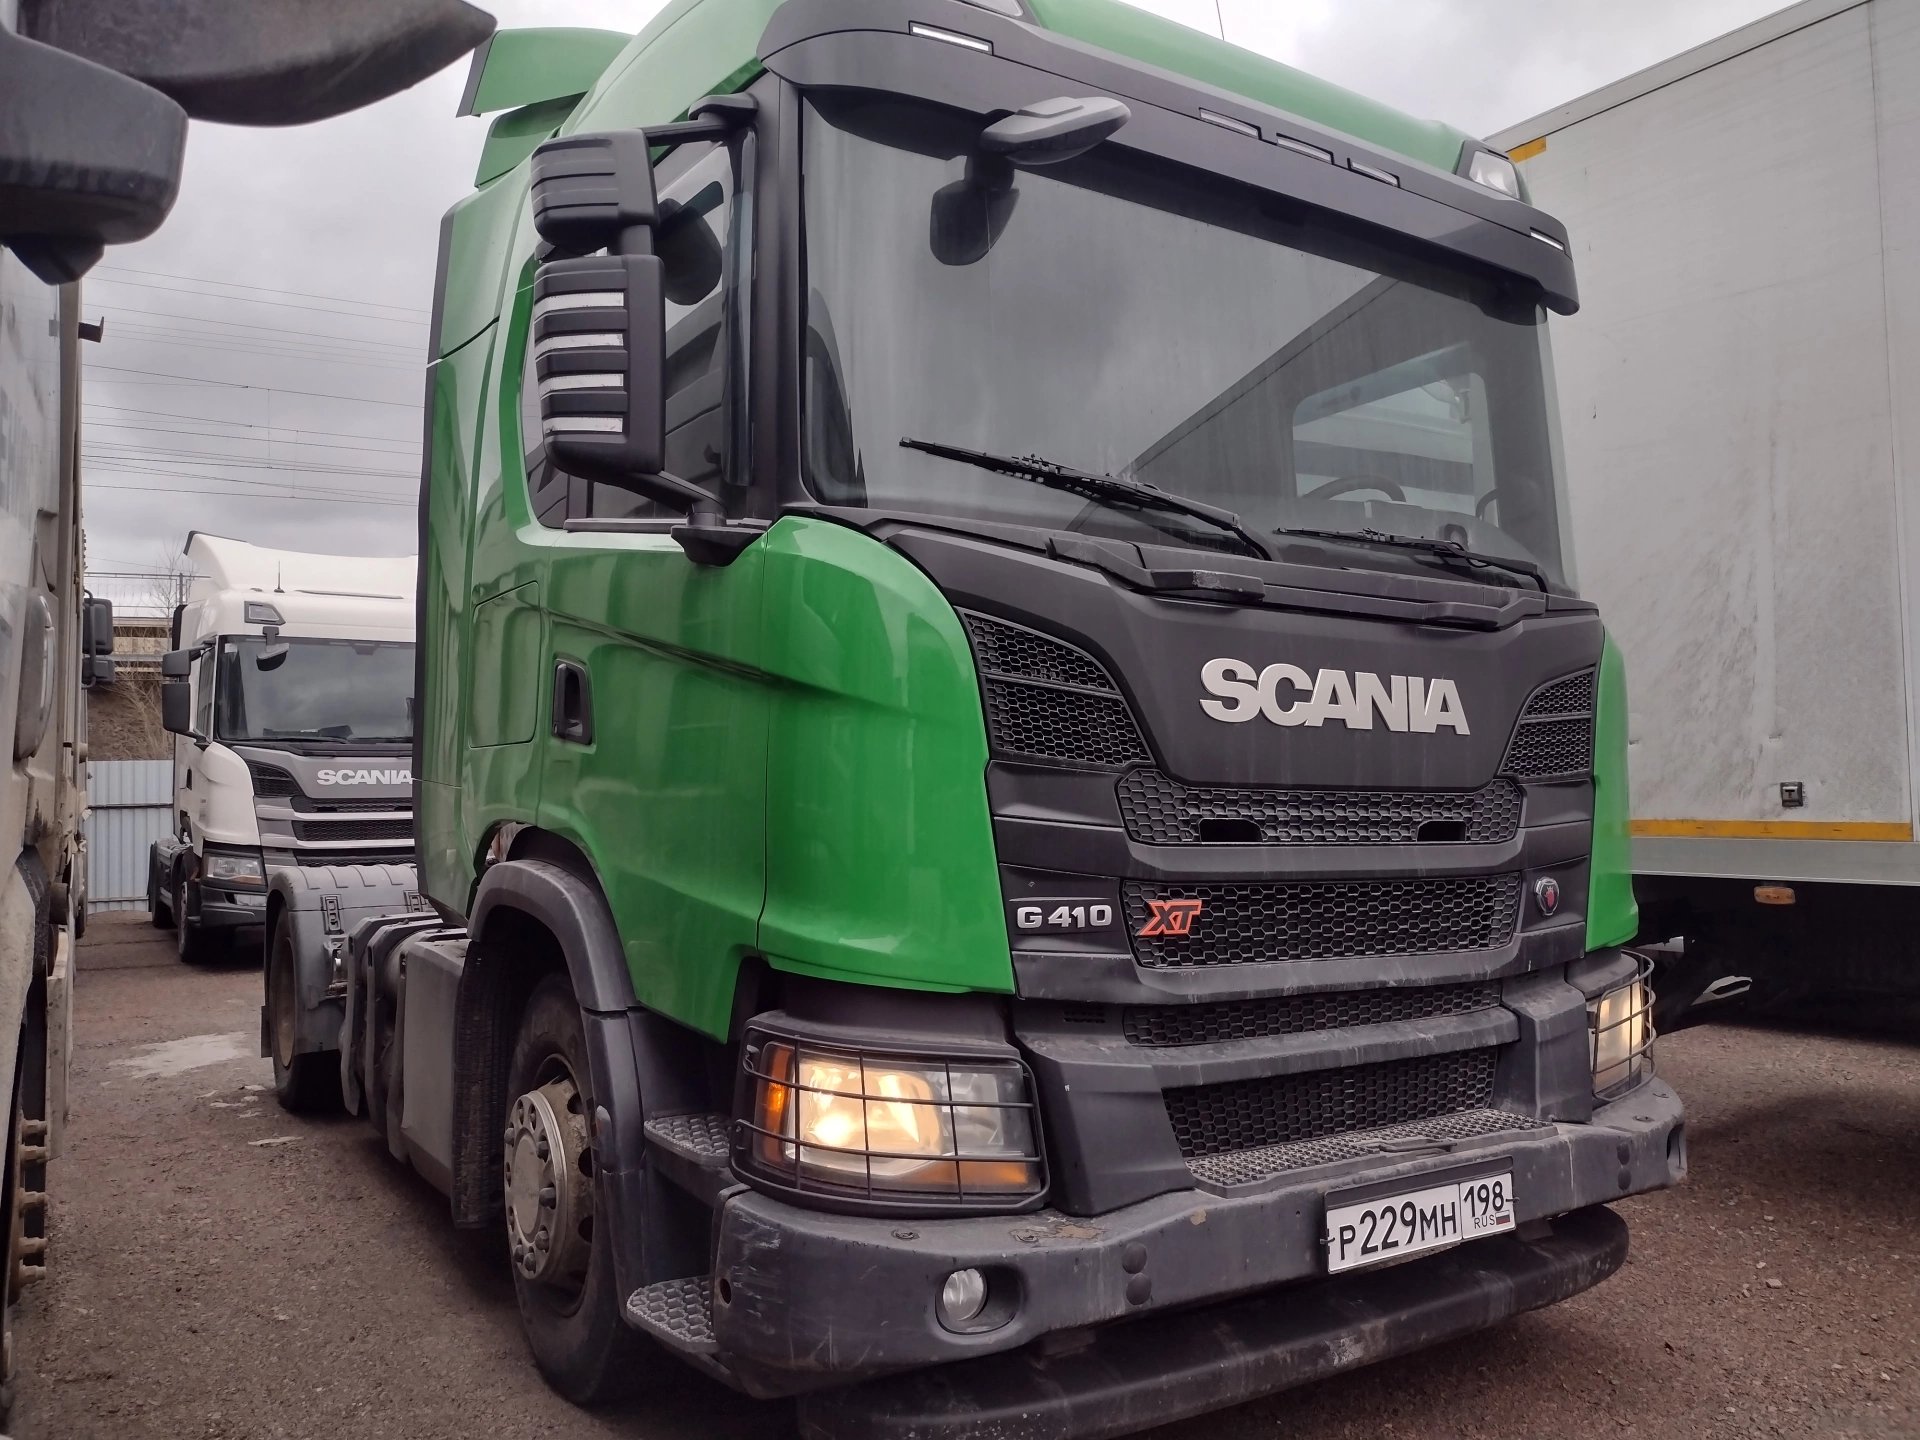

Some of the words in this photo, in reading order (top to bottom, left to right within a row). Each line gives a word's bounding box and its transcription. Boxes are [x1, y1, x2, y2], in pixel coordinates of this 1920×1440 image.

[1199, 657, 1471, 735] SCANIA
[316, 769, 413, 786] SCANIA
[1017, 906, 1043, 929] G
[1047, 904, 1113, 928] 410
[1138, 900, 1202, 937] XT
[1339, 1200, 1457, 1261] Р229МН
[1463, 1180, 1505, 1218] 198
[1473, 1213, 1495, 1230] RUS
